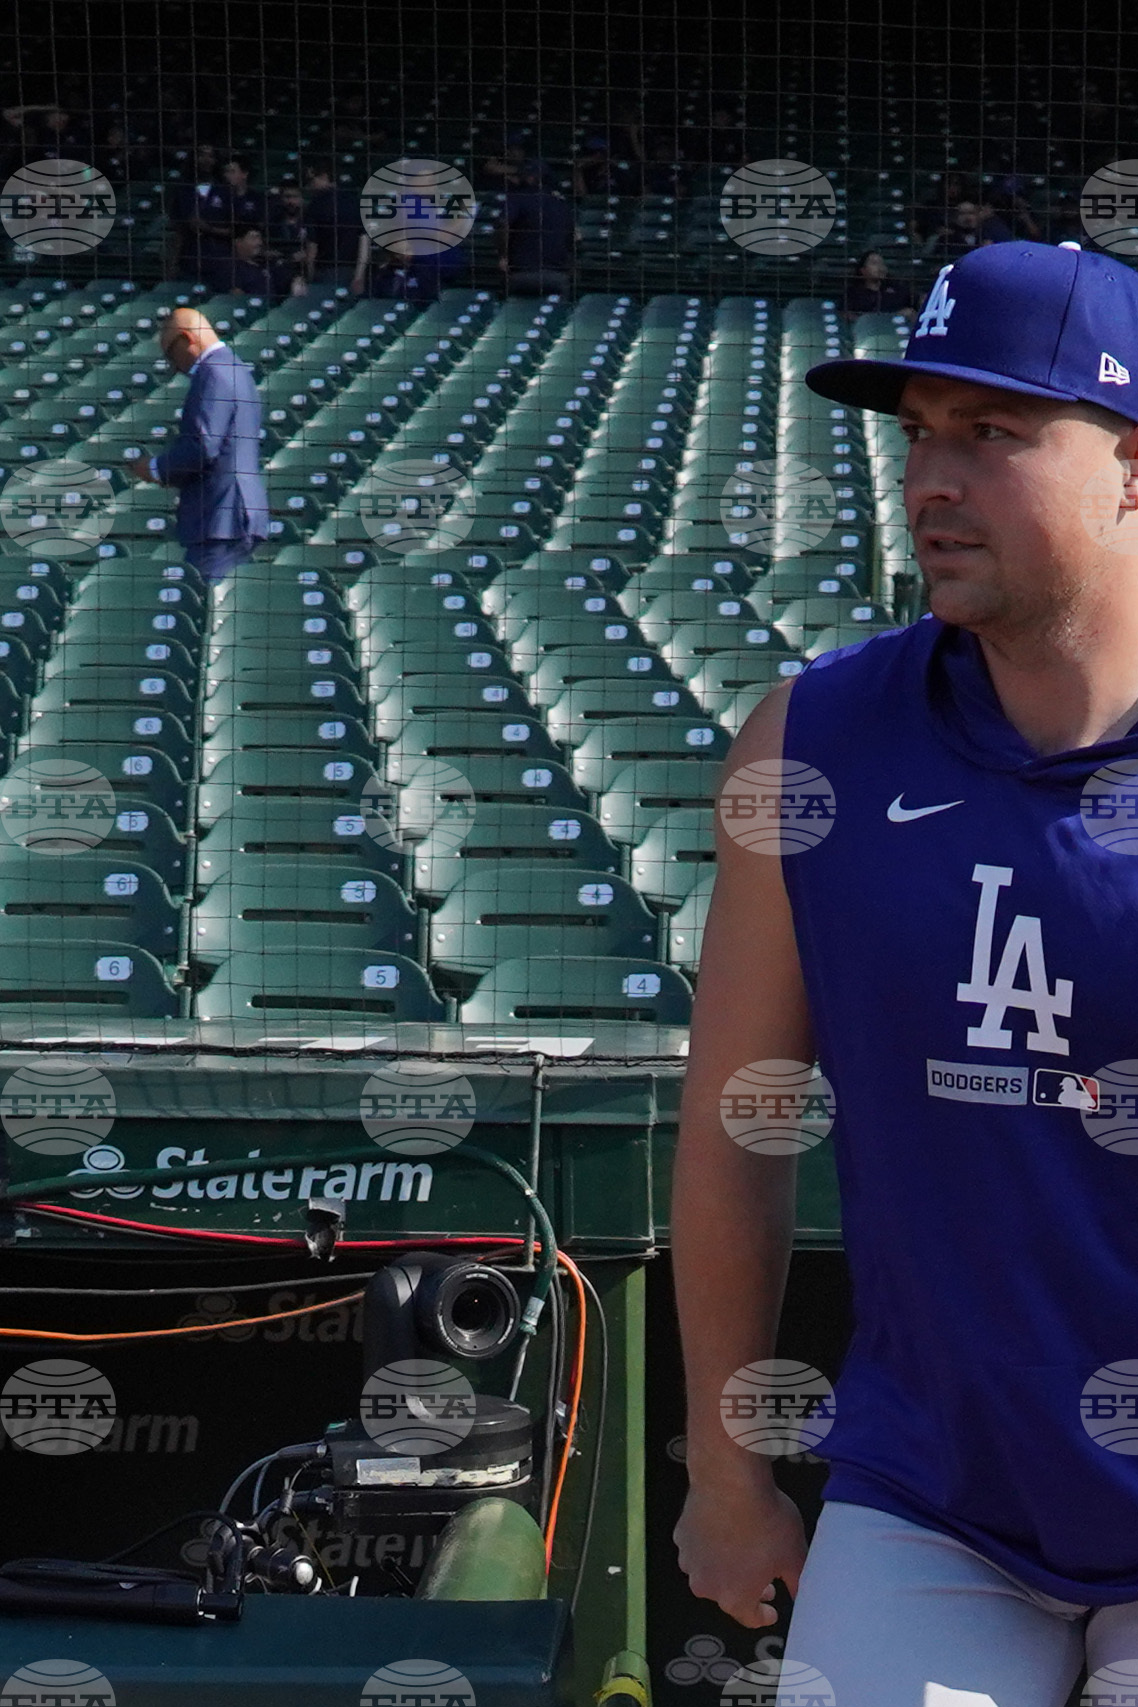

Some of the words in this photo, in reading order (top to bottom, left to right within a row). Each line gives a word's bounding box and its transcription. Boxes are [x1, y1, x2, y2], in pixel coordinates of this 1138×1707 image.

[915, 264, 956, 338] LA
[109, 960, 120, 976] 6
[956, 863, 1074, 1056] LA
[376, 970, 387, 985] 5
[637, 978, 648, 993] 4
[930, 1069, 1023, 1095] DODGERS
